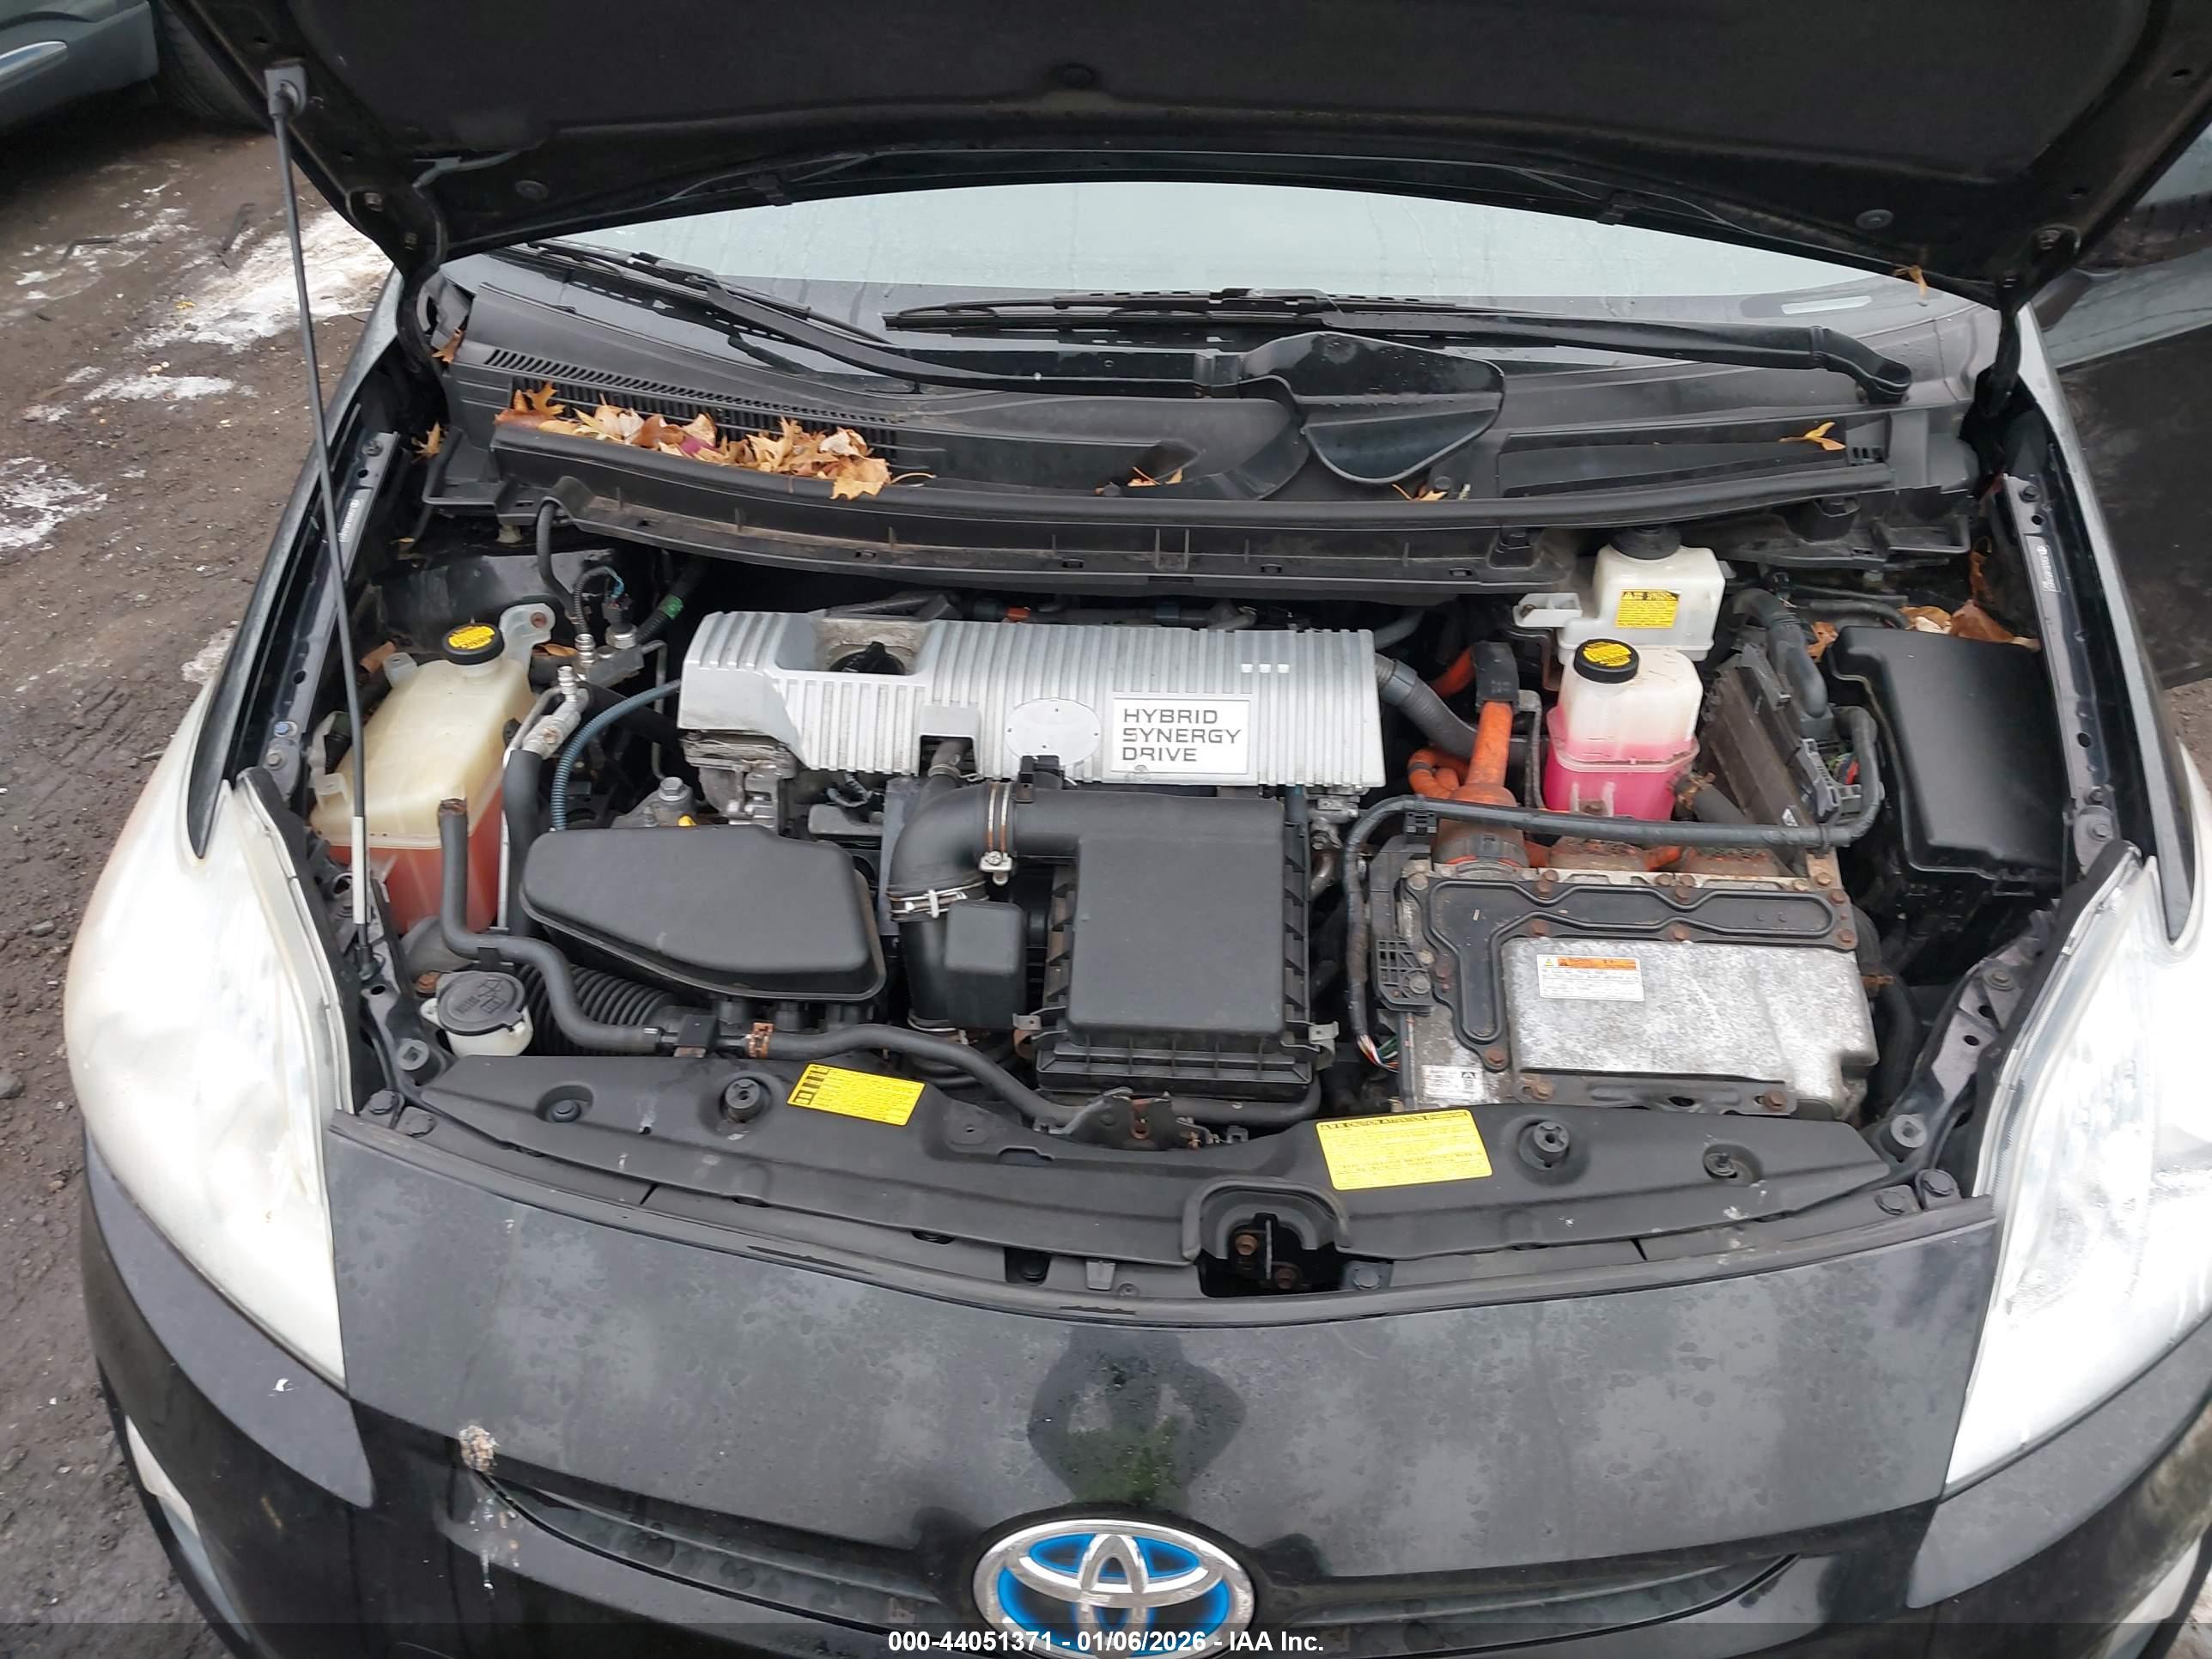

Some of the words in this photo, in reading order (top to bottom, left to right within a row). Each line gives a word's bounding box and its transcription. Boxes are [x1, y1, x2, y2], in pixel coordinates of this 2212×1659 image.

[1123, 708, 1218, 724] HYBRID
[1122, 727, 1242, 744] SYNERGY
[1121, 746, 1197, 762] DRIVE
